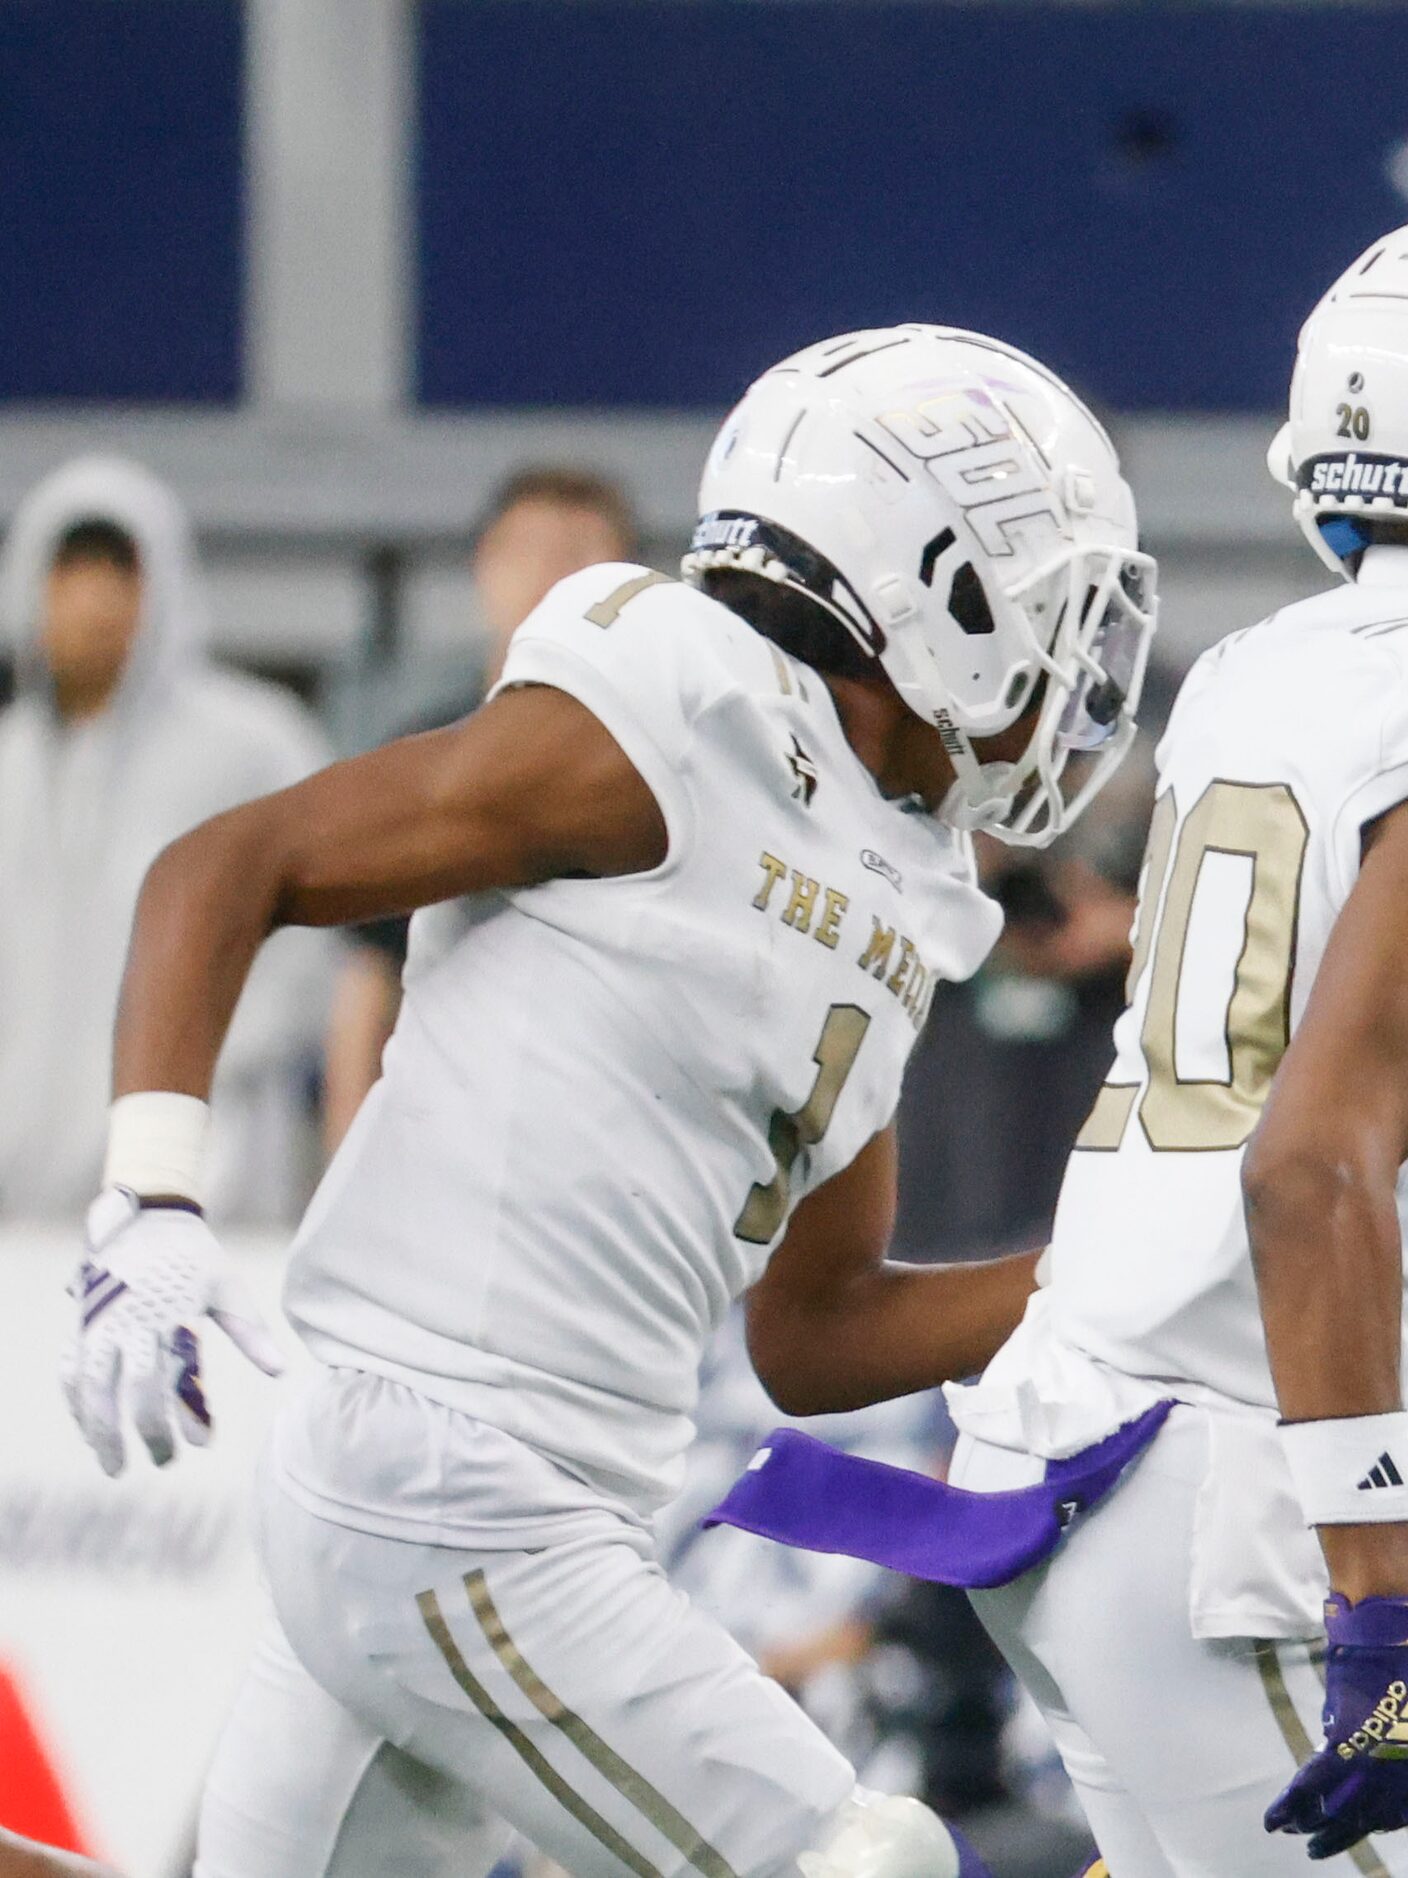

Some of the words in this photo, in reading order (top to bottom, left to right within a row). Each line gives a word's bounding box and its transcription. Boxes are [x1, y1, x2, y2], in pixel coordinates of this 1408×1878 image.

[1336, 402, 1370, 441] 20
[752, 851, 849, 949] THE
[733, 1003, 872, 1245] 1
[1337, 1680, 1407, 1760] adidas
